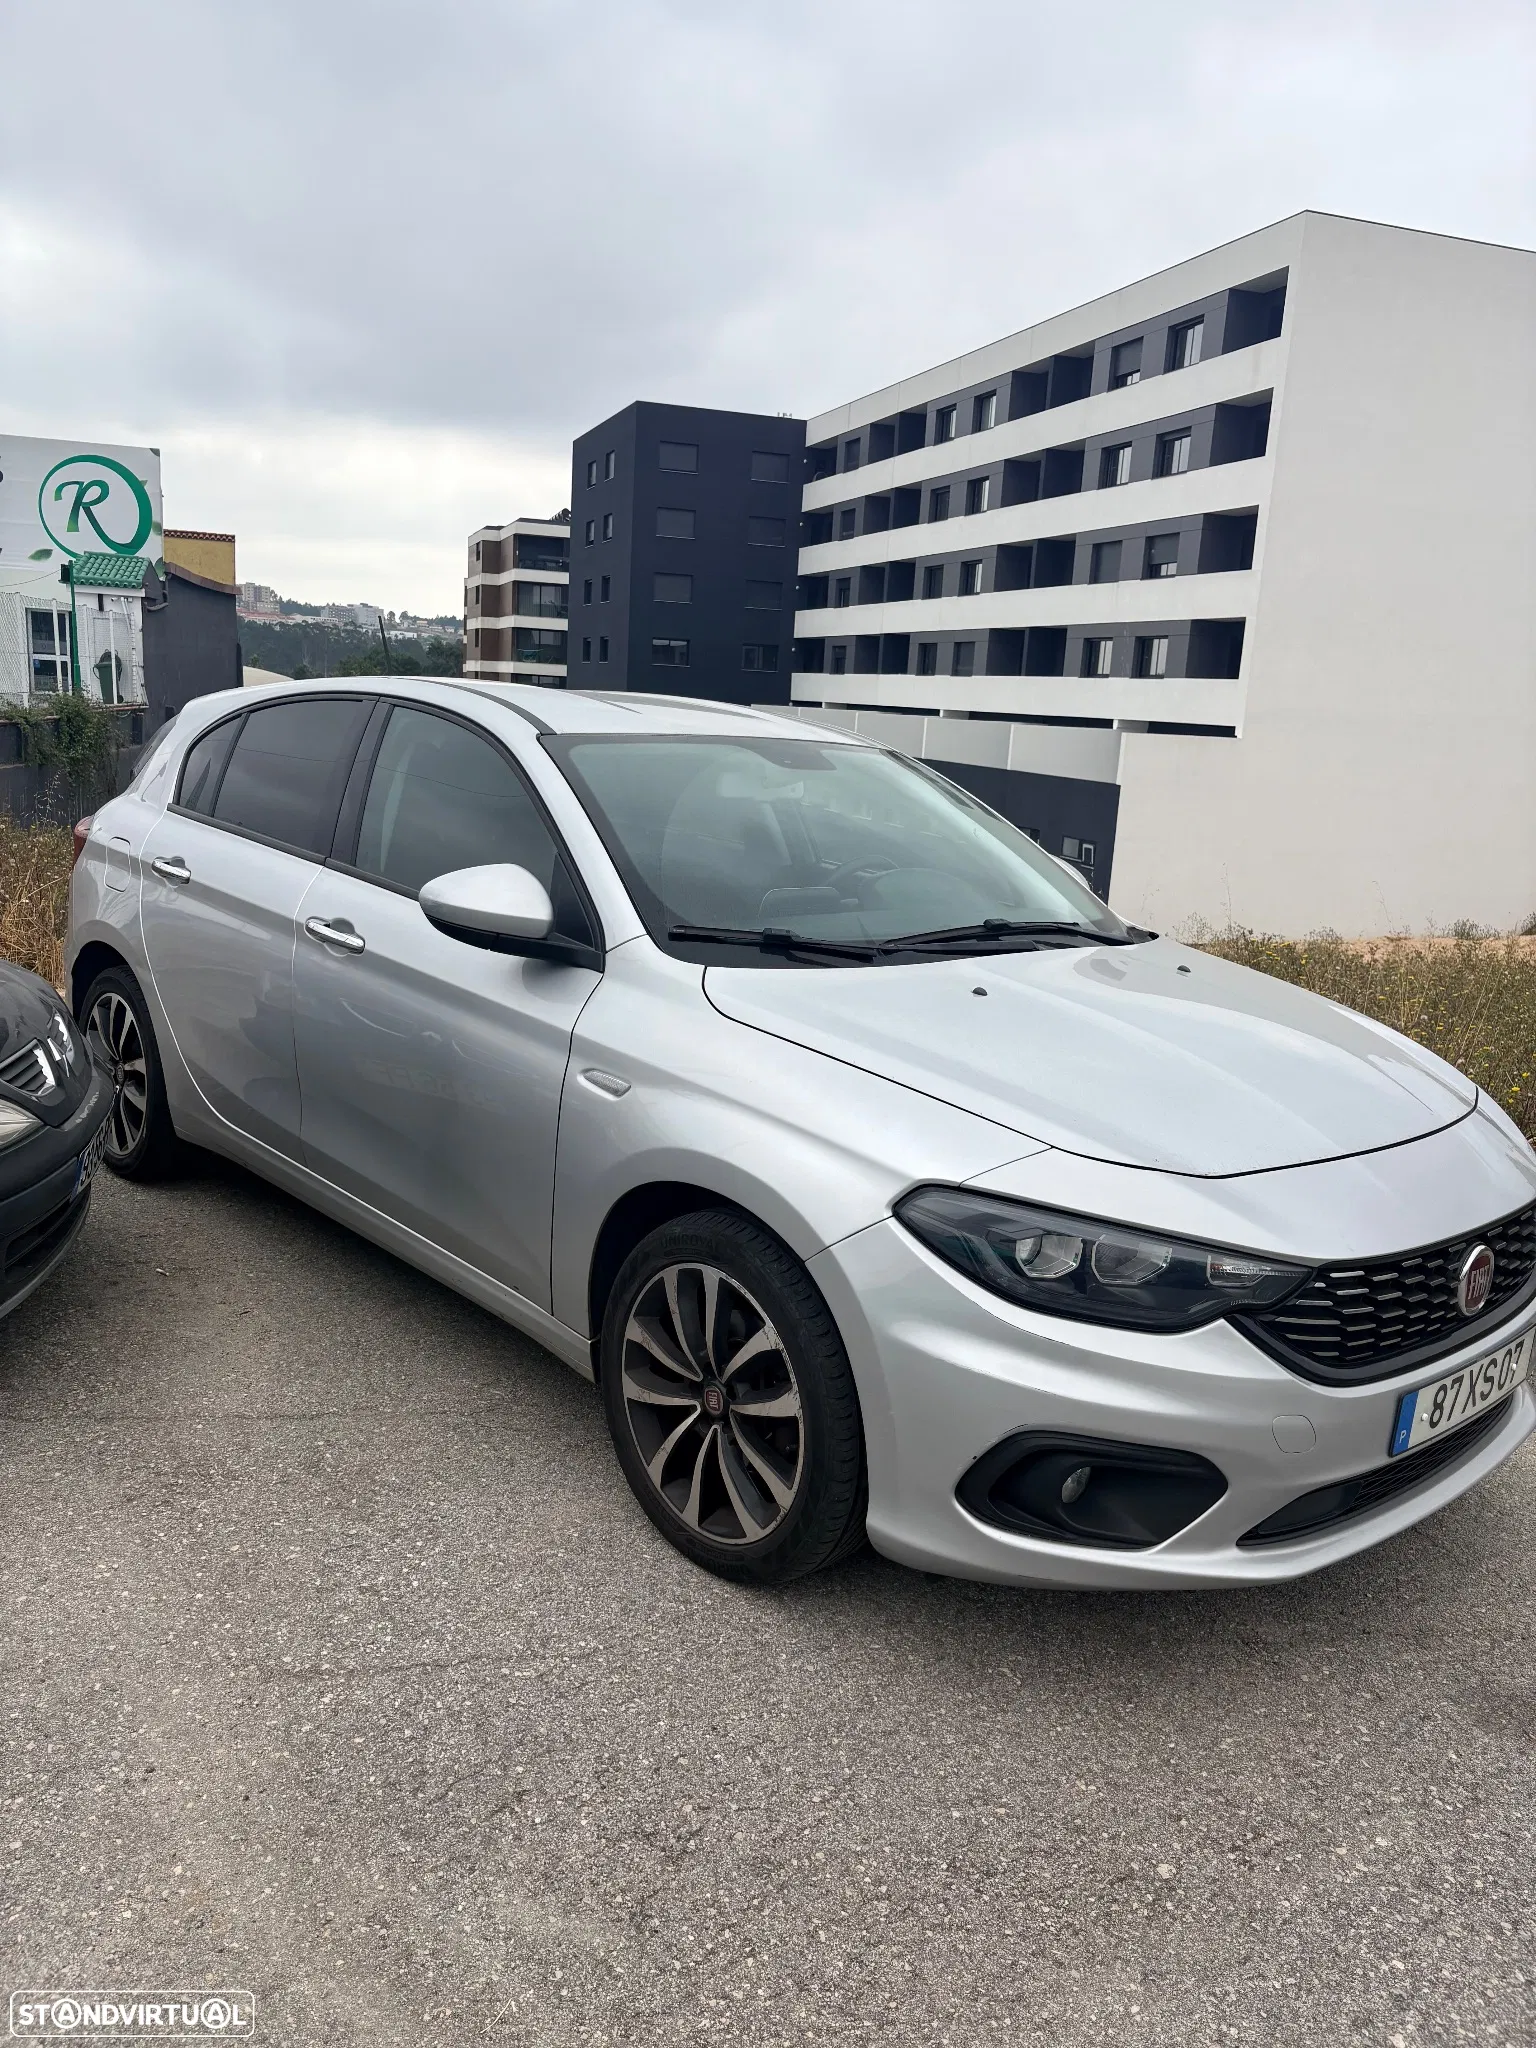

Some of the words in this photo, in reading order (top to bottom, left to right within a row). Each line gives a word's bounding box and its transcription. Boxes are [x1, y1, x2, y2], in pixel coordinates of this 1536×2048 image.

[54, 479, 126, 551] R
[660, 1233, 717, 1252] UNIROYA
[1467, 1264, 1490, 1300] FIAT
[1429, 1338, 1525, 1429] 87XS07
[708, 1391, 719, 1409] FIAT
[1399, 1430, 1407, 1444] P
